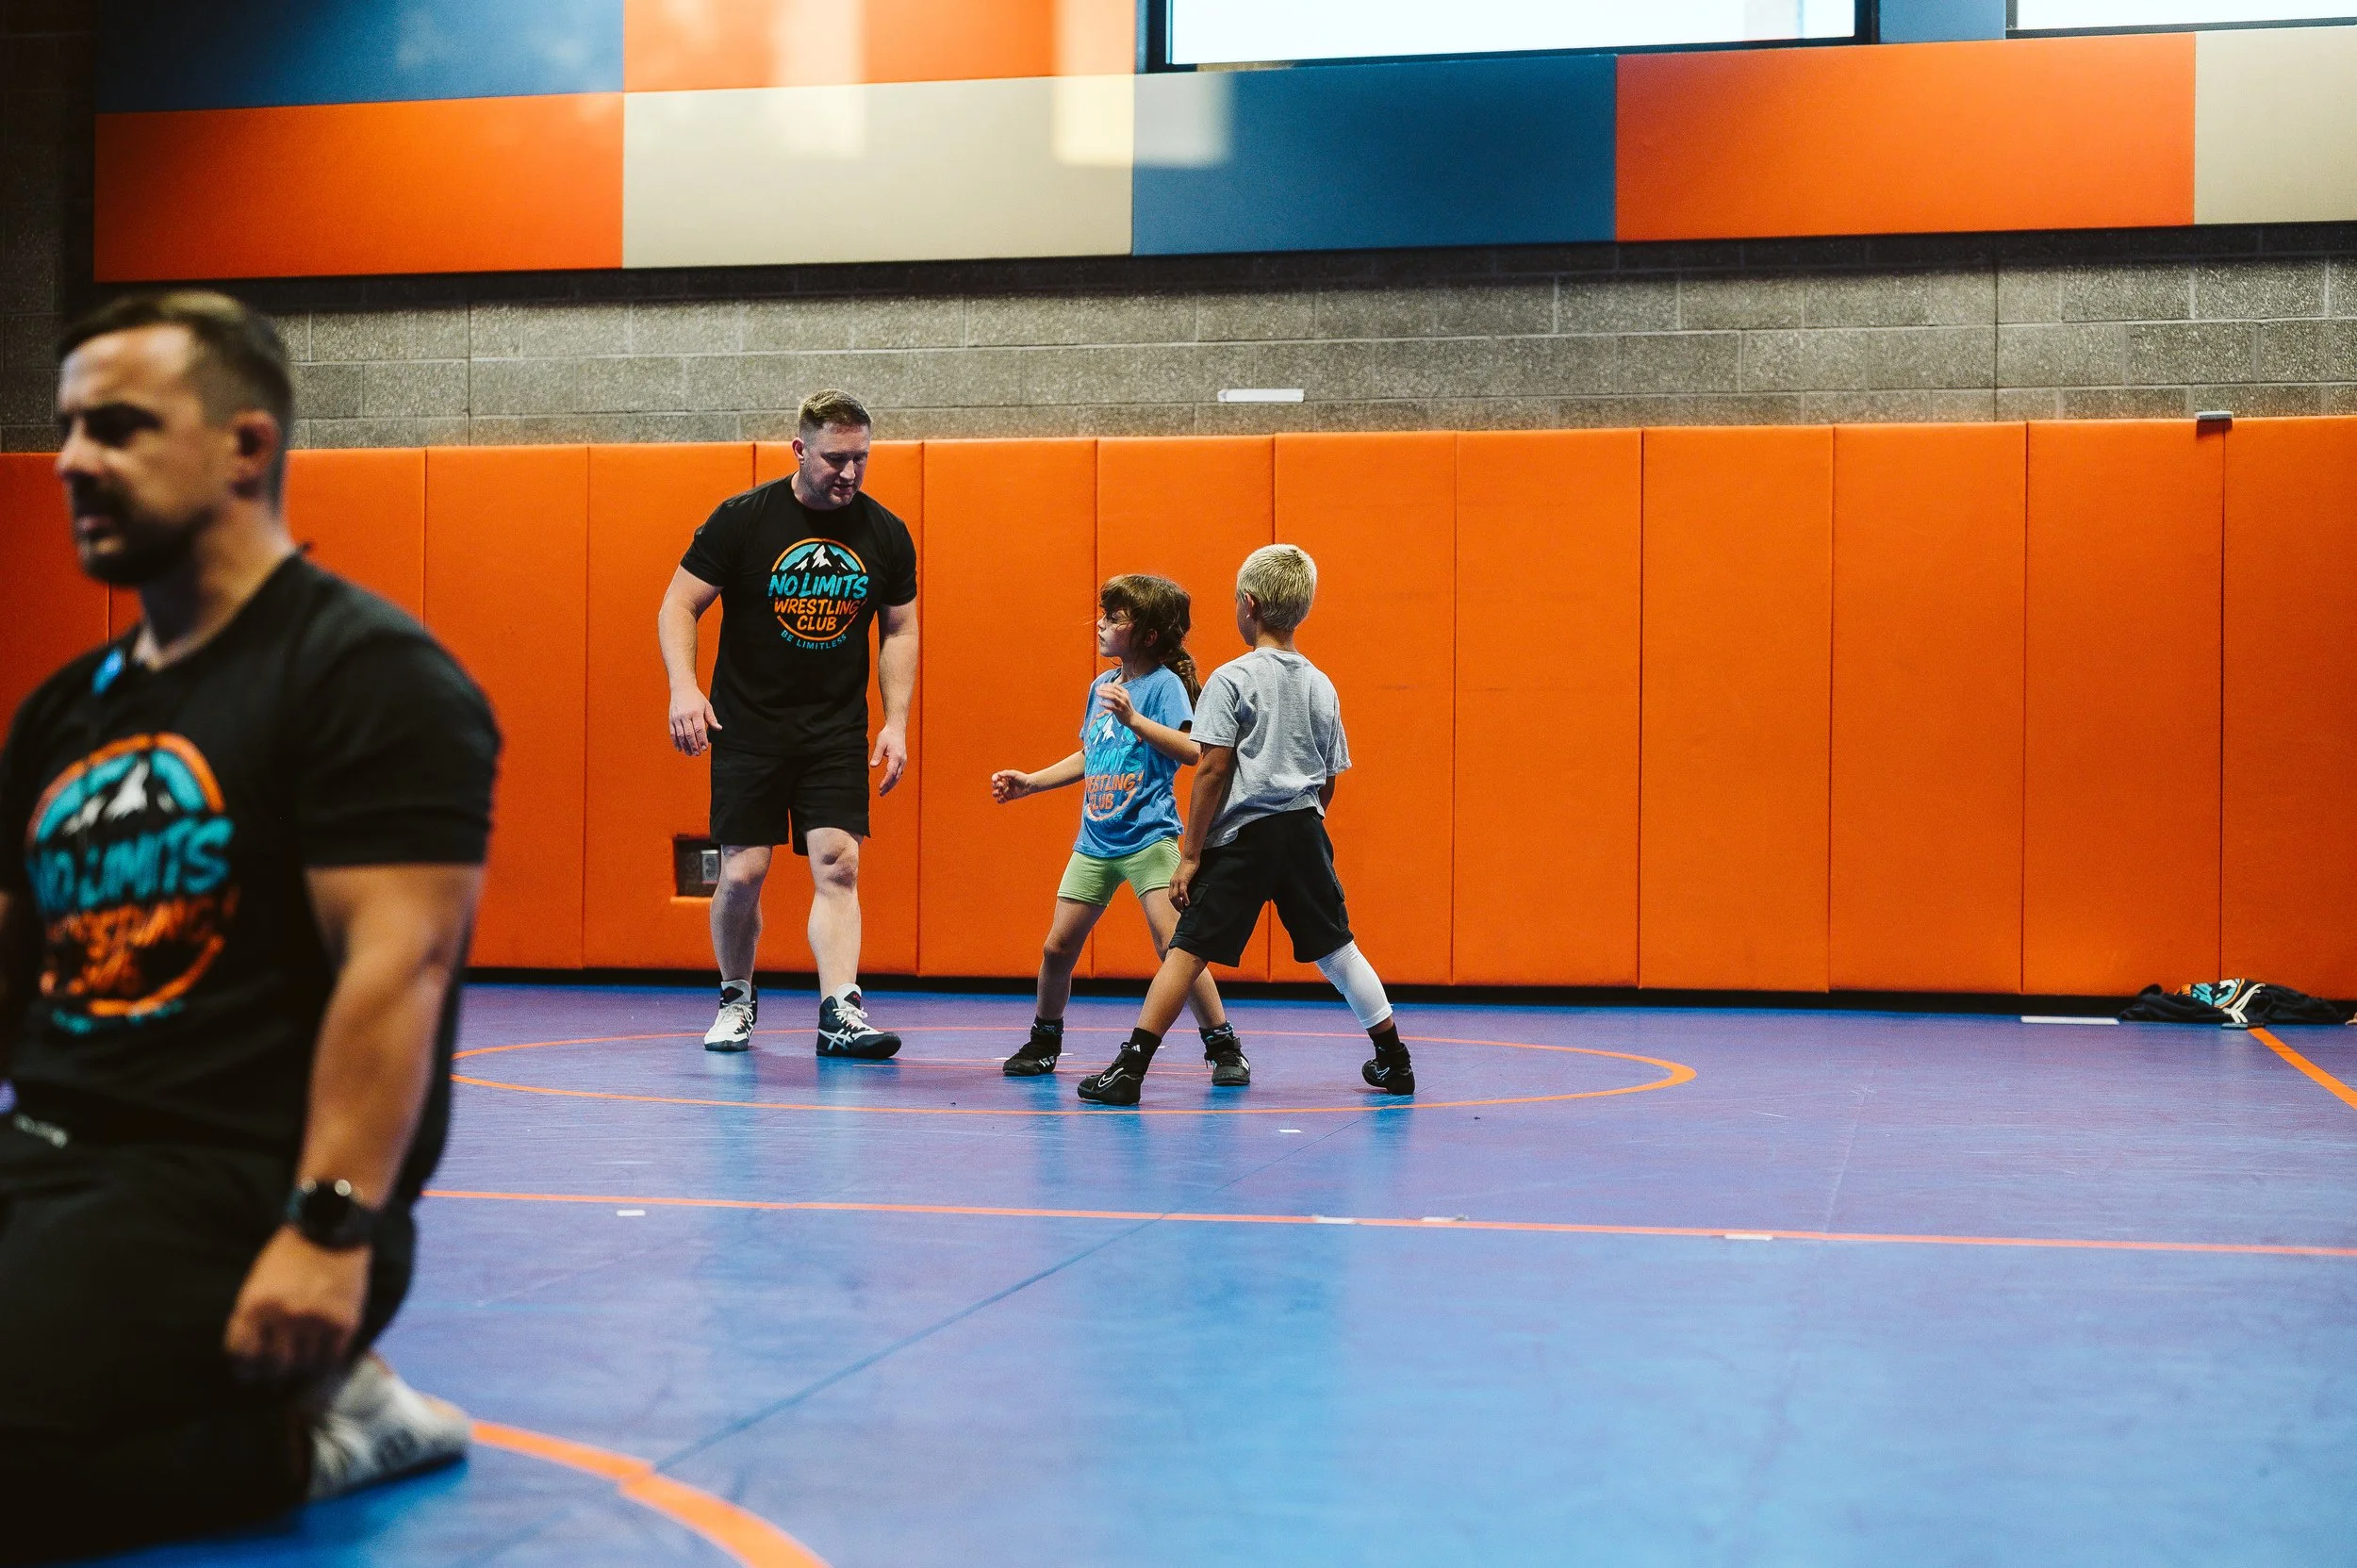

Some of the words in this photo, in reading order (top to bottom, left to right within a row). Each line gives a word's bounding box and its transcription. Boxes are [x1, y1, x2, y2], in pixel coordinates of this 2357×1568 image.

[767, 572, 799, 597] NO
[799, 572, 869, 599] LIMITS
[774, 598, 861, 616] WRESTLING
[797, 615, 837, 631] CLUB
[781, 629, 794, 642] BE
[796, 634, 847, 651] LIMITLESS
